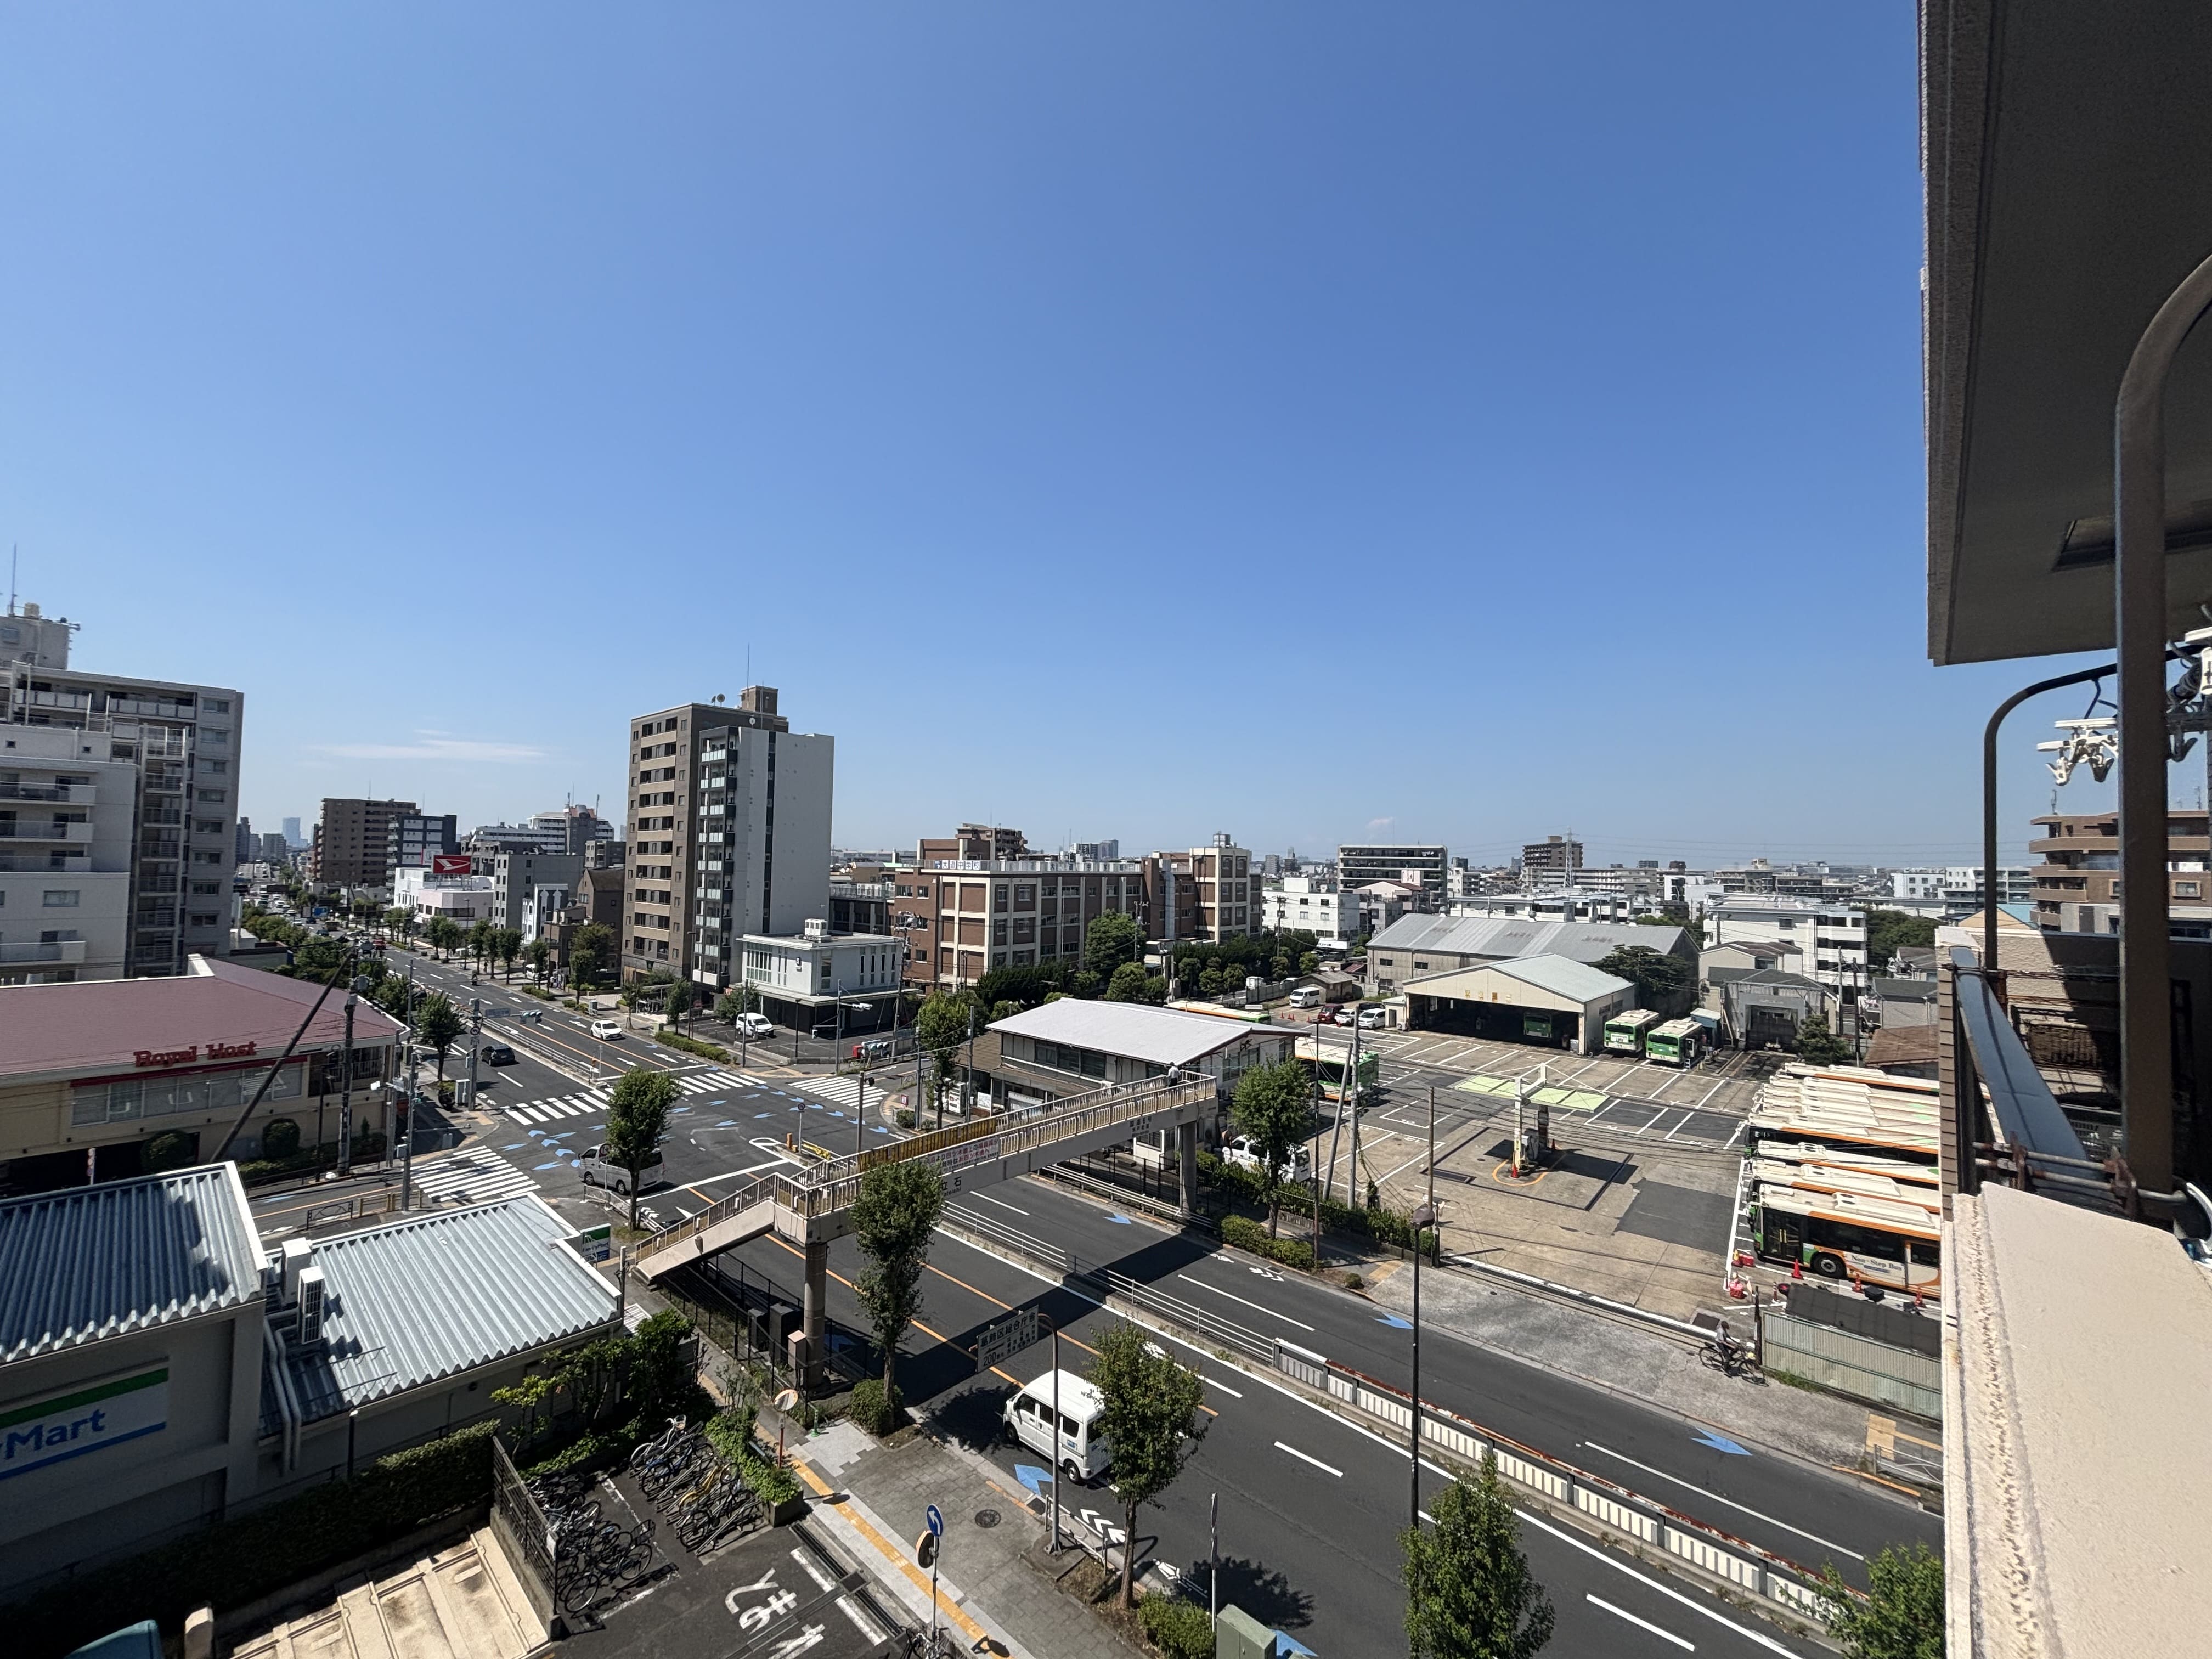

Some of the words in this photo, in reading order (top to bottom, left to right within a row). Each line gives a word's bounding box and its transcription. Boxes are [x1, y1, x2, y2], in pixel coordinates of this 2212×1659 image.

[133, 1046, 198, 1068] Royal
[206, 1041, 257, 1060] Host
[0, 1409, 106, 1460] Mart
